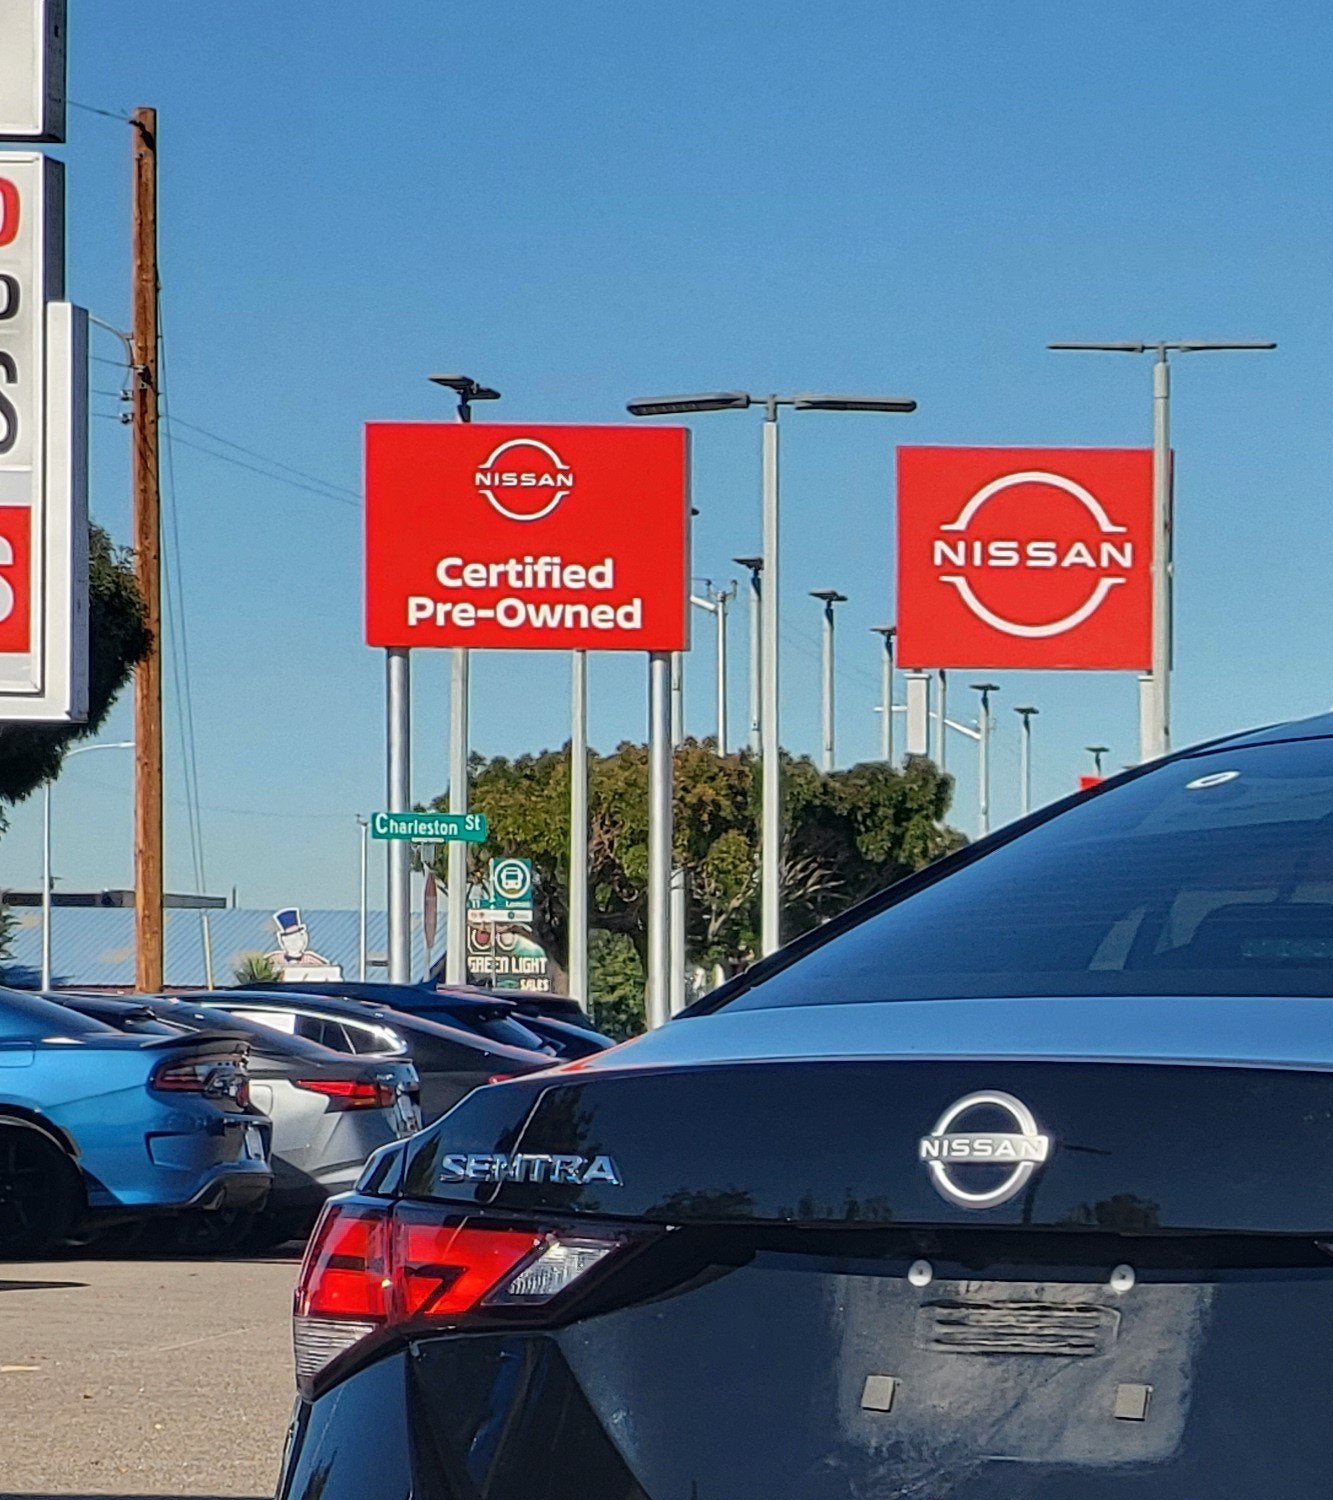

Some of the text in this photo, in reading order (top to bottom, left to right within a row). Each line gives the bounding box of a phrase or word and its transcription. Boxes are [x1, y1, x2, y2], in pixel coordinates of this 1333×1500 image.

[475, 471, 574, 489] NISSAN
[932, 540, 1133, 569] NISSAN
[436, 557, 614, 591] Certified
[407, 597, 642, 631] Pre-Owned
[375, 813, 481, 836] Charleston St
[511, 956, 548, 974] LIGHT
[520, 978, 549, 991] SALES
[920, 1137, 1047, 1159] NISSAN
[440, 1153, 623, 1186] SENTRA
